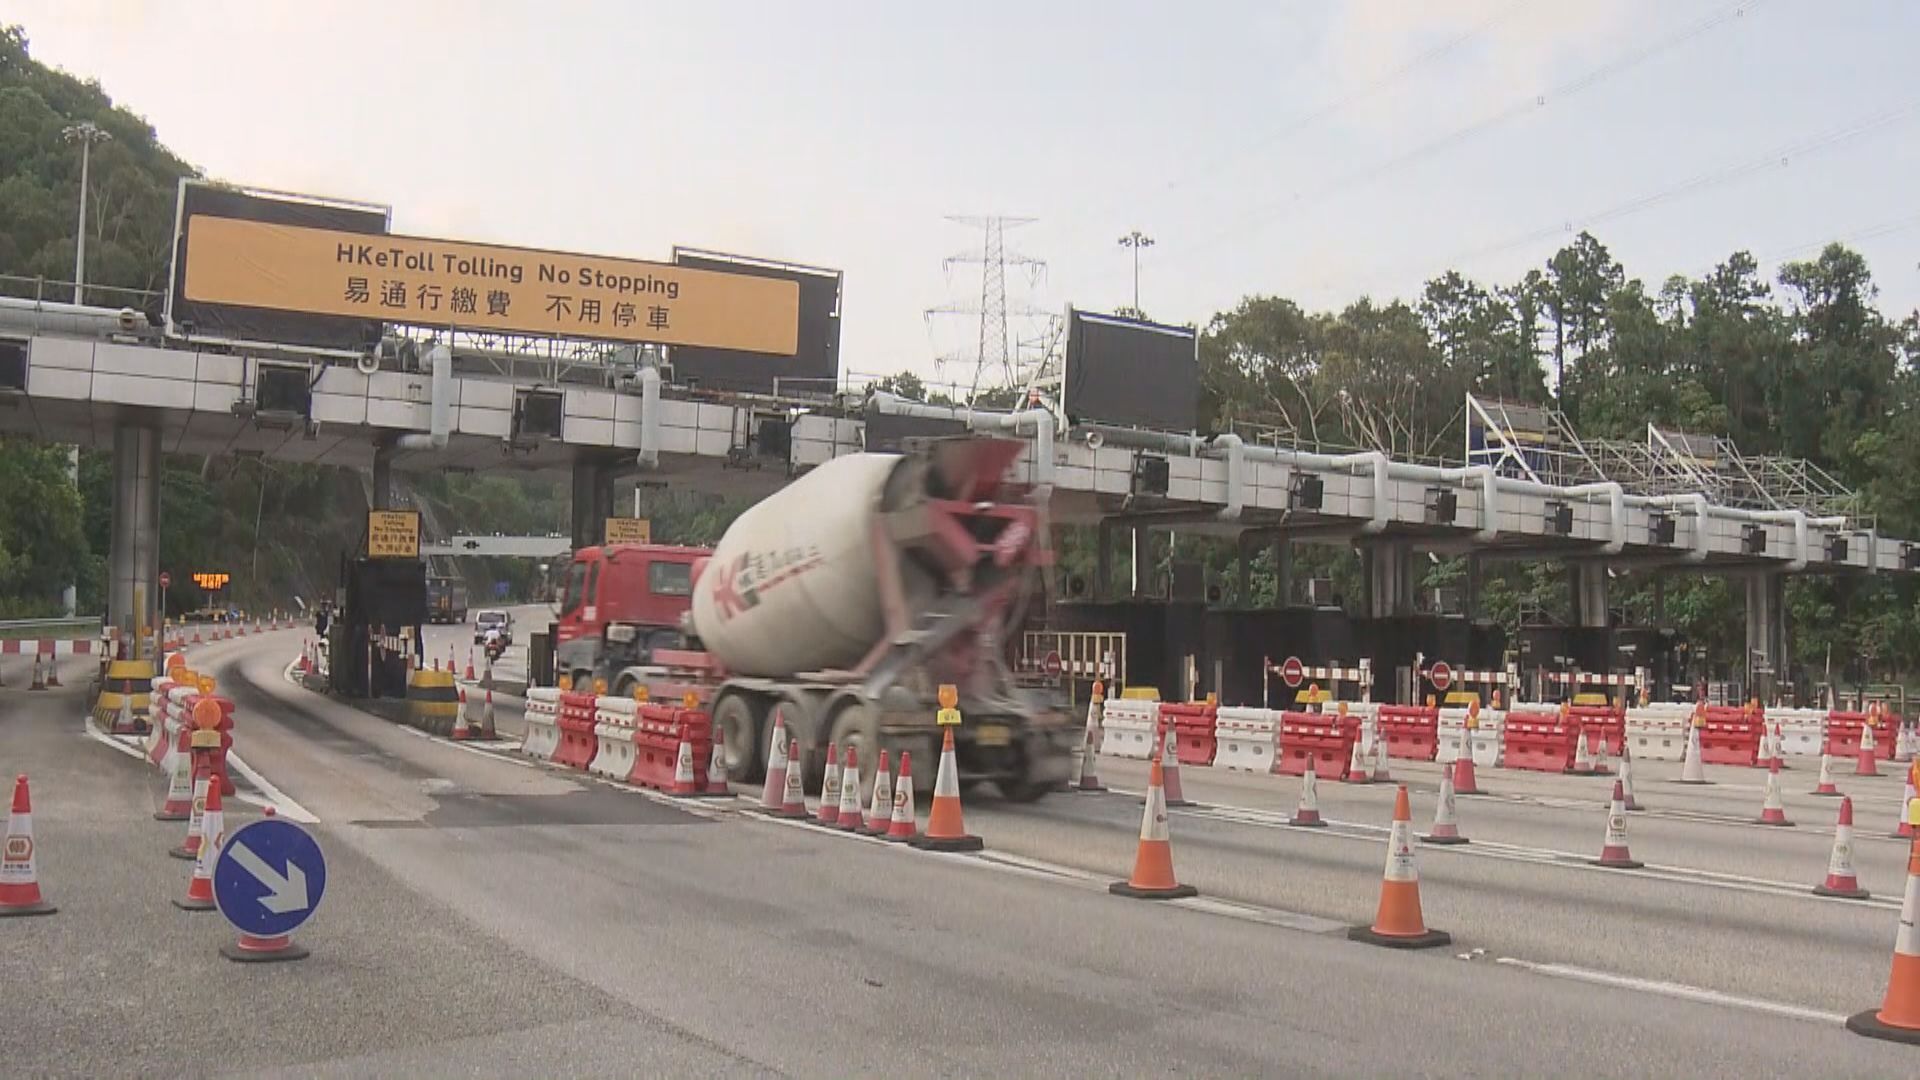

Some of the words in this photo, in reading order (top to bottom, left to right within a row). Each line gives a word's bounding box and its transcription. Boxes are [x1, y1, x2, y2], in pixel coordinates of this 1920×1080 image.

[336, 242, 435, 272] HKeToll
[442, 253, 524, 284] Tolling
[538, 263, 571, 285] No
[578, 267, 680, 300] Stopping
[344, 276, 511, 317] 易通行繳費
[545, 293, 671, 332] 不用停車
